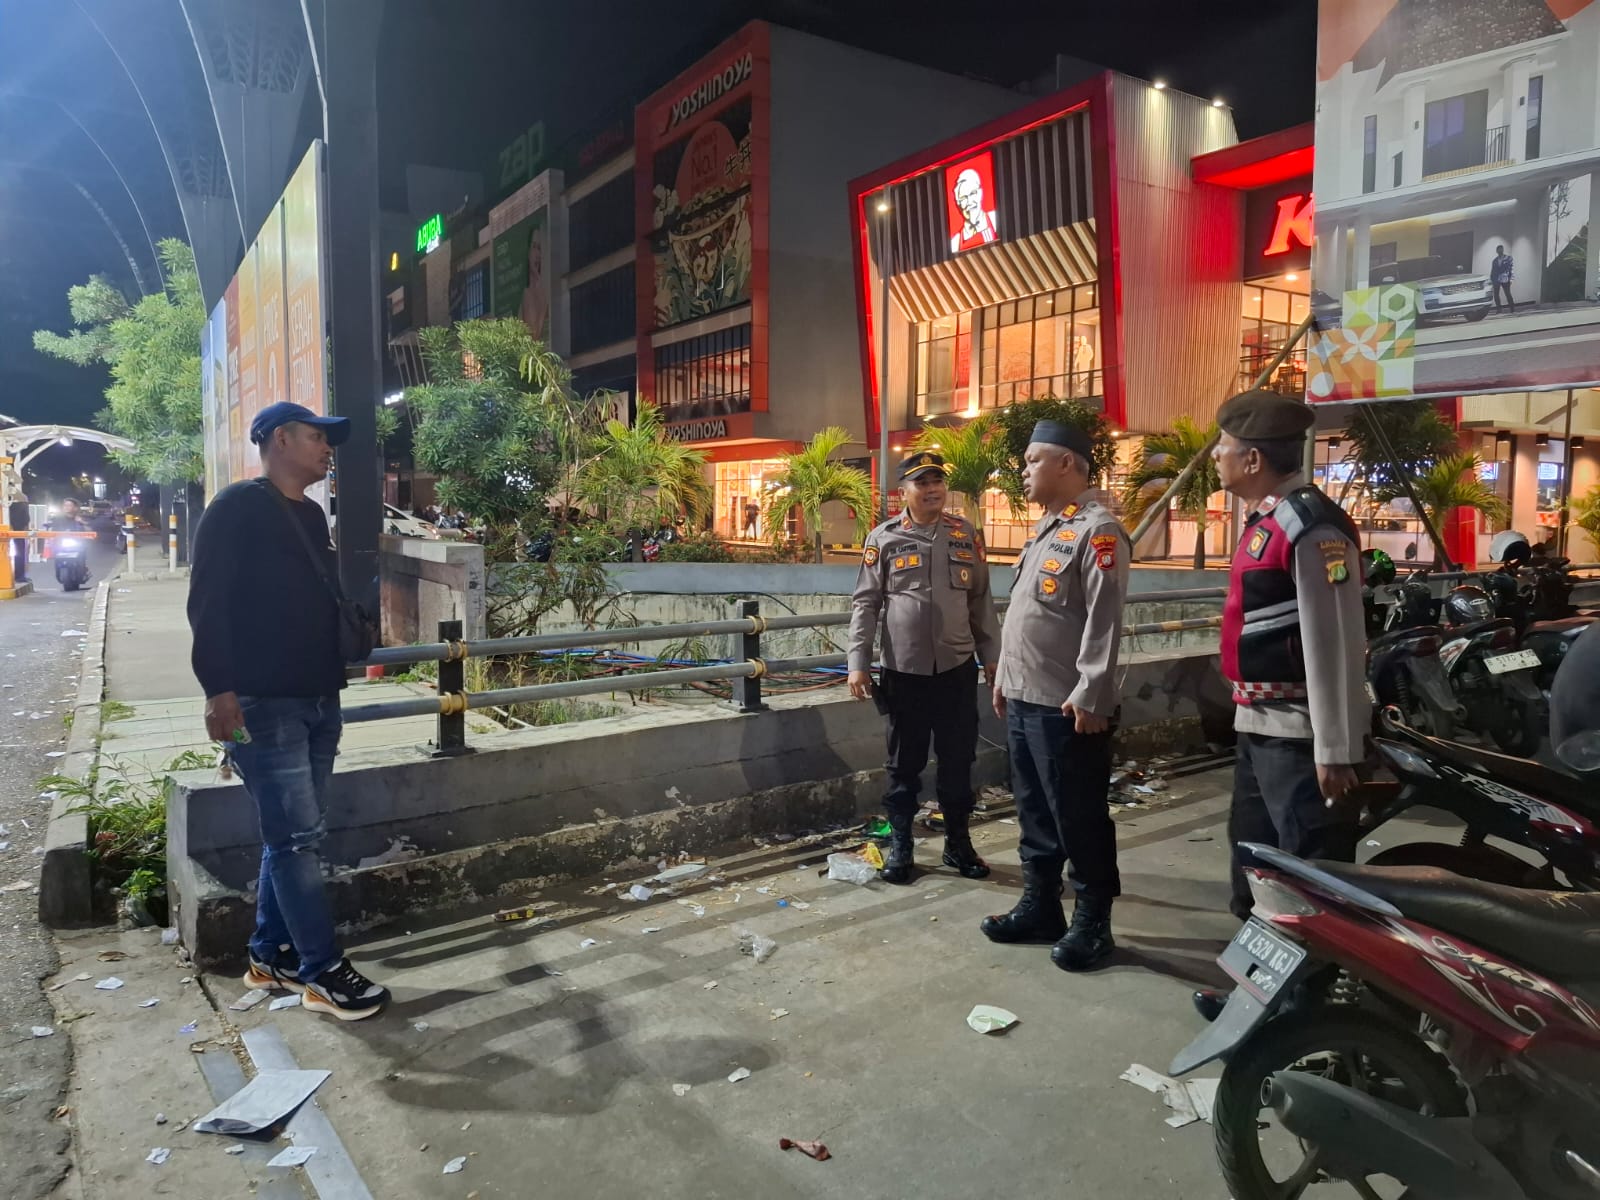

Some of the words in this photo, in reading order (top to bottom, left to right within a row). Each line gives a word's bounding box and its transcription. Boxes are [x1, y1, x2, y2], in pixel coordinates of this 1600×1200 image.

[671, 51, 753, 125] YOSHINOYA
[416, 213, 442, 252] ABUBA
[667, 419, 726, 442] YOSHINOYA
[948, 540, 973, 550] POLRI
[1047, 543, 1074, 555] POLRI
[1238, 928, 1252, 945] B
[1247, 934, 1274, 960] 4529
